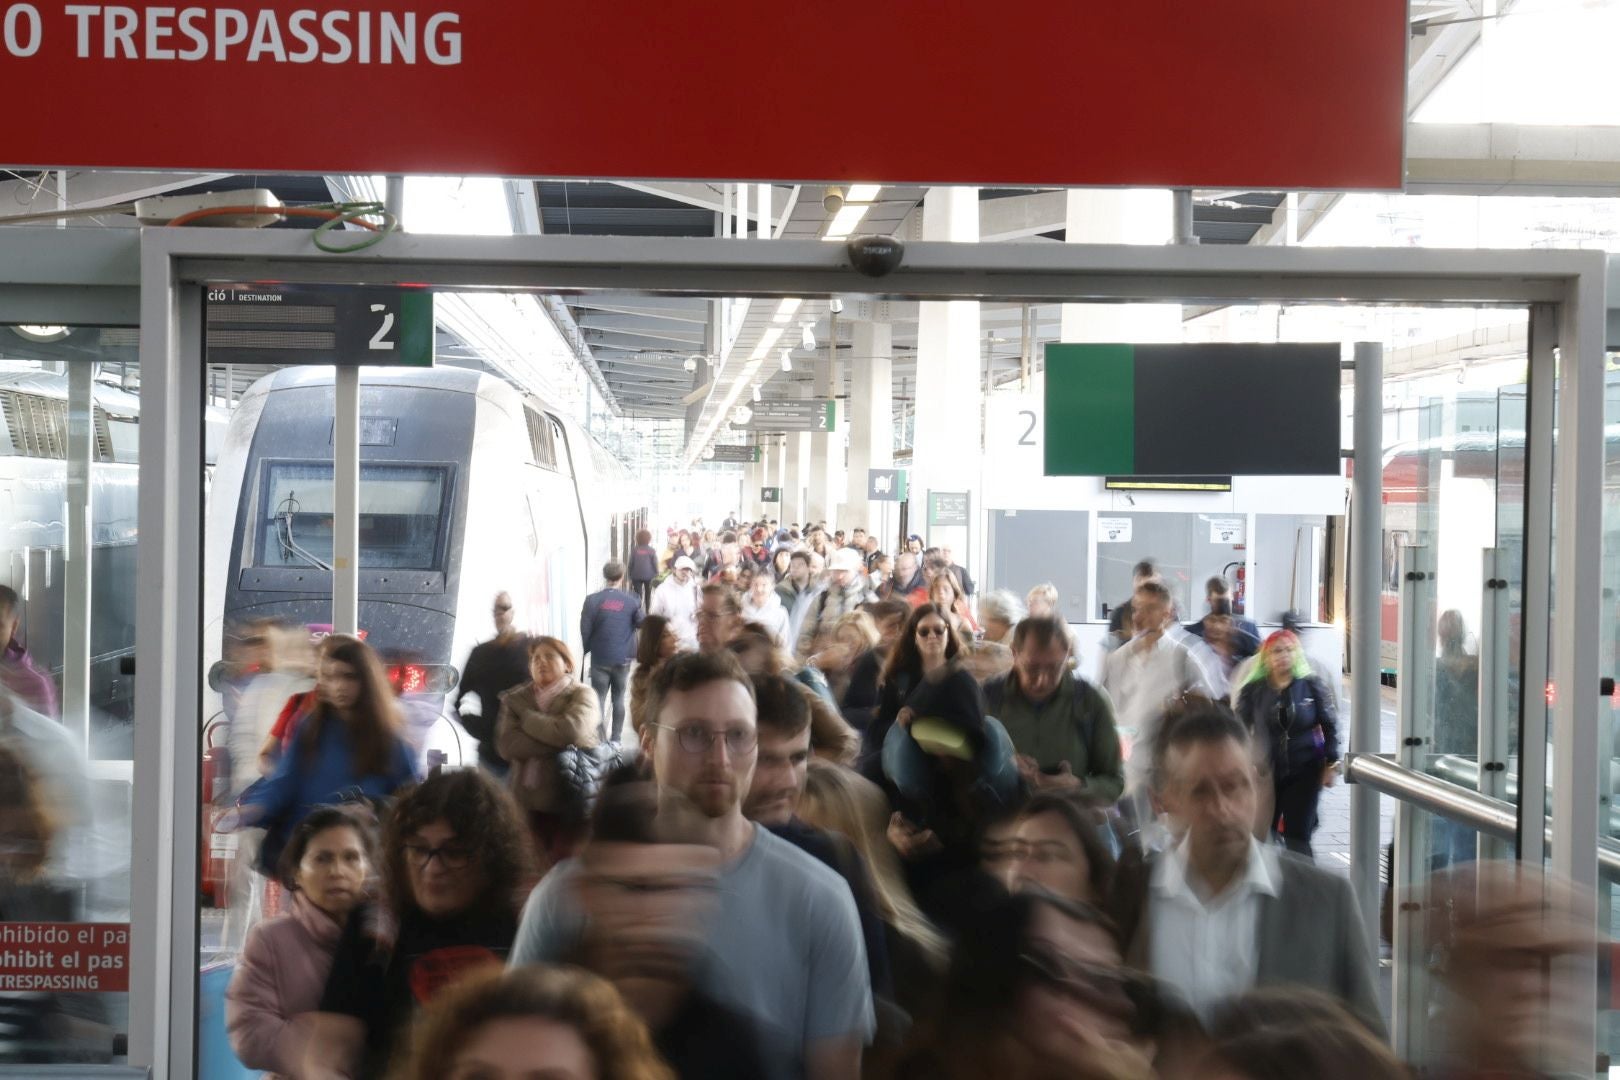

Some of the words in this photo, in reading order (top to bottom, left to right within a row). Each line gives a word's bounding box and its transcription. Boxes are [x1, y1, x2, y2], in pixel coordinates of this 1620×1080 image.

[65, 5, 462, 65] TRESPASSING
[239, 294, 282, 302] DESTINATION
[369, 303, 395, 350] 2
[819, 416, 827, 428] 2
[1018, 410, 1037, 446] 2
[0, 926, 70, 944] hibido
[77, 926, 94, 944] el
[103, 929, 130, 948] pa
[0, 950, 55, 968] hibit
[61, 951, 80, 969] el
[88, 954, 124, 972] pas
